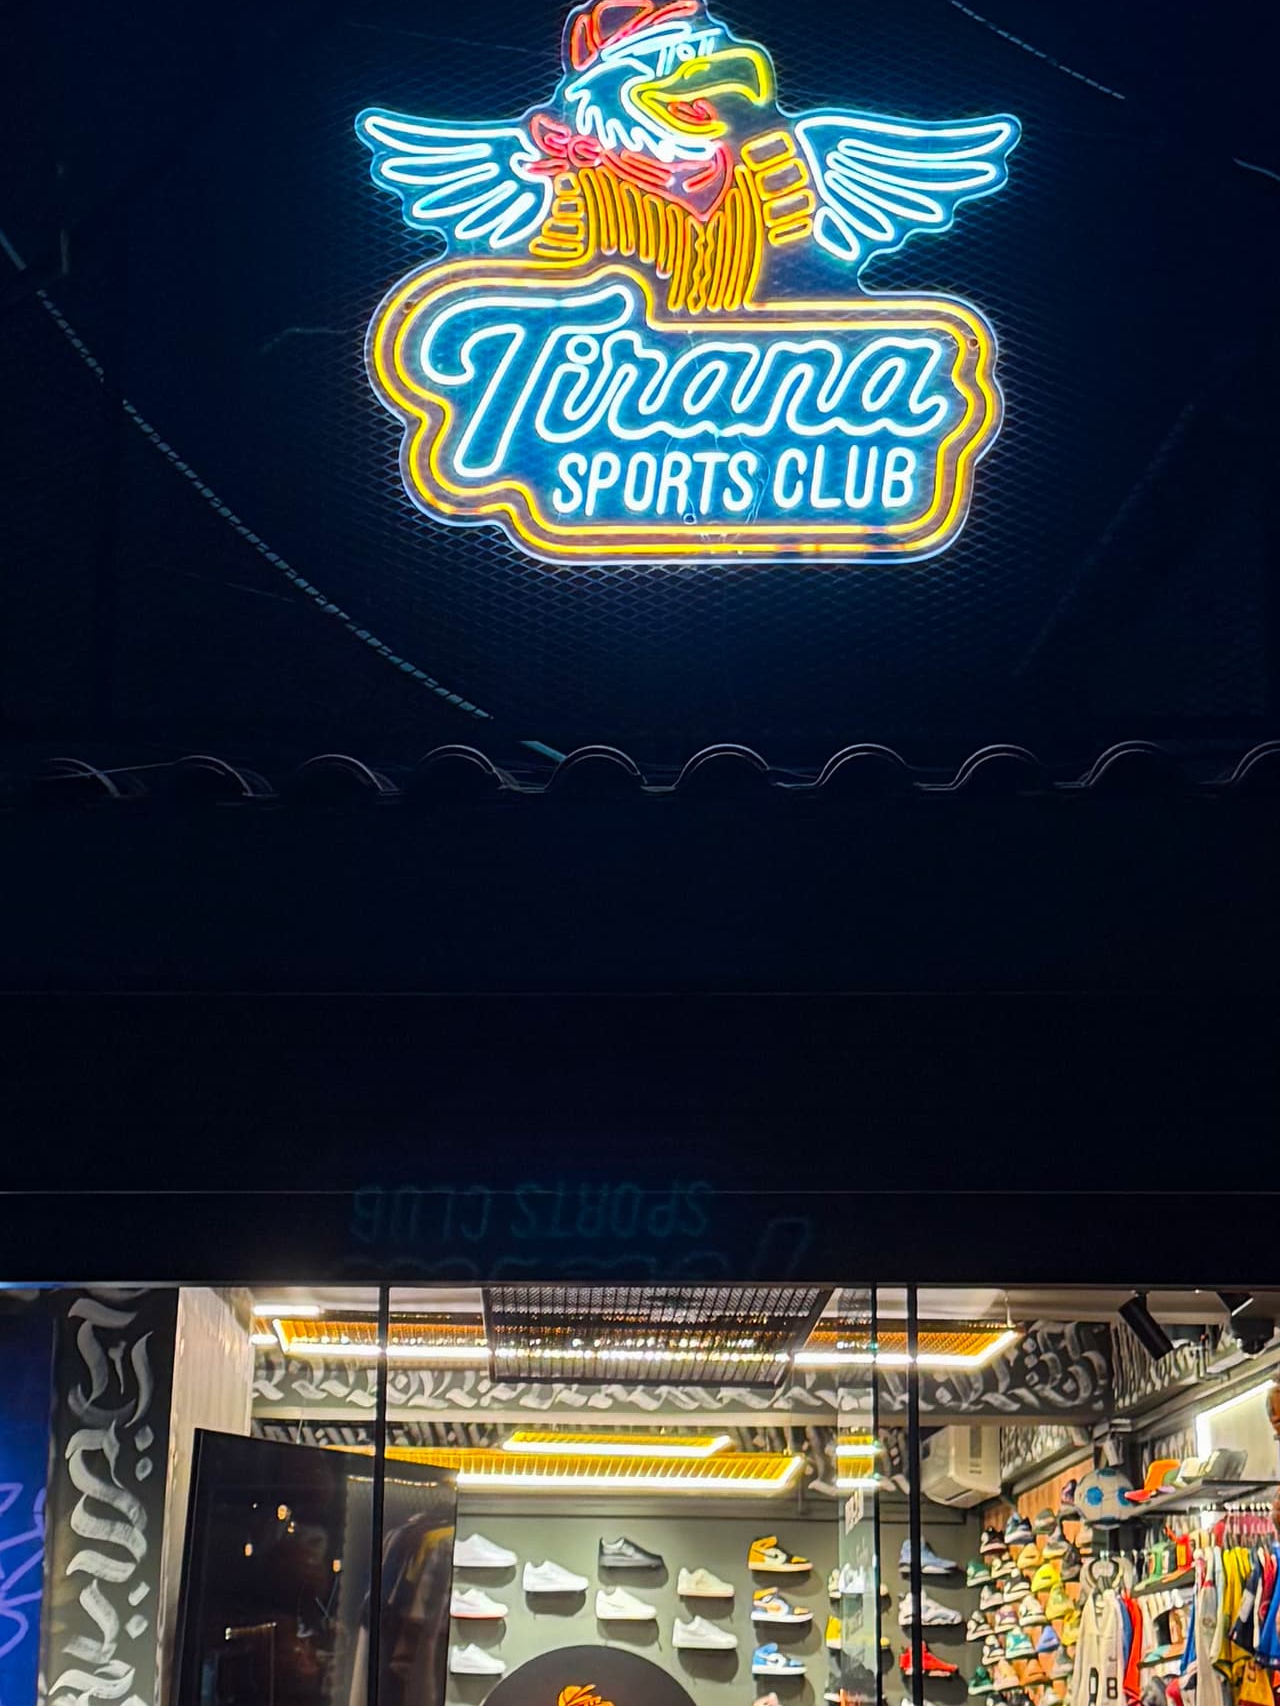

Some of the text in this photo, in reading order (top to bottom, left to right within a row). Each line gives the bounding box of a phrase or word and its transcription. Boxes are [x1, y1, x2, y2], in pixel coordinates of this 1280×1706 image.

[419, 283, 949, 478] Tirana
[552, 445, 916, 514] SPORTS CLUB
